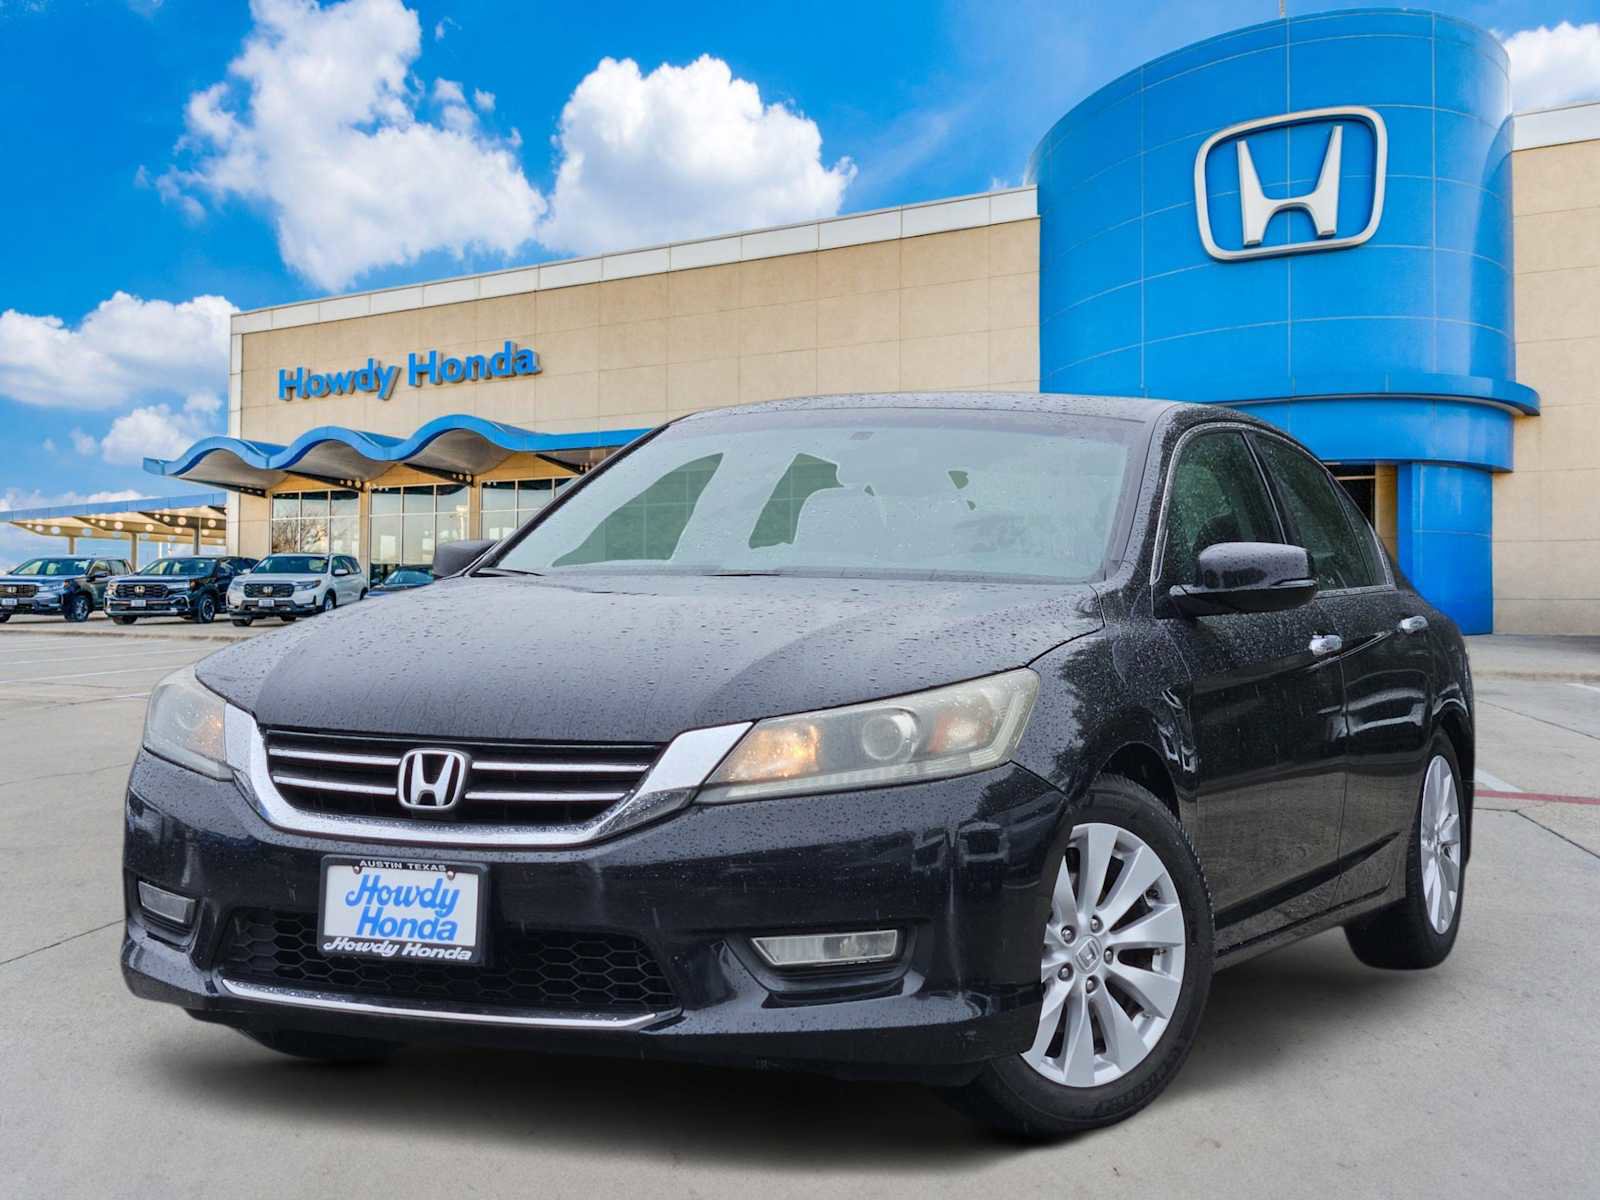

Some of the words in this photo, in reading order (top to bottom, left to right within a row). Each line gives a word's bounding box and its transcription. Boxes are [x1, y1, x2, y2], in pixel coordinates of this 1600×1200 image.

[278, 357, 401, 401] Howdy
[407, 340, 542, 388] Honda
[359, 860, 403, 870] AUSTIN
[407, 863, 447, 872] TEXAS
[345, 874, 460, 918] Howdy
[356, 907, 458, 941] Honda
[323, 937, 400, 958] Howdy
[401, 942, 473, 961] Honda
